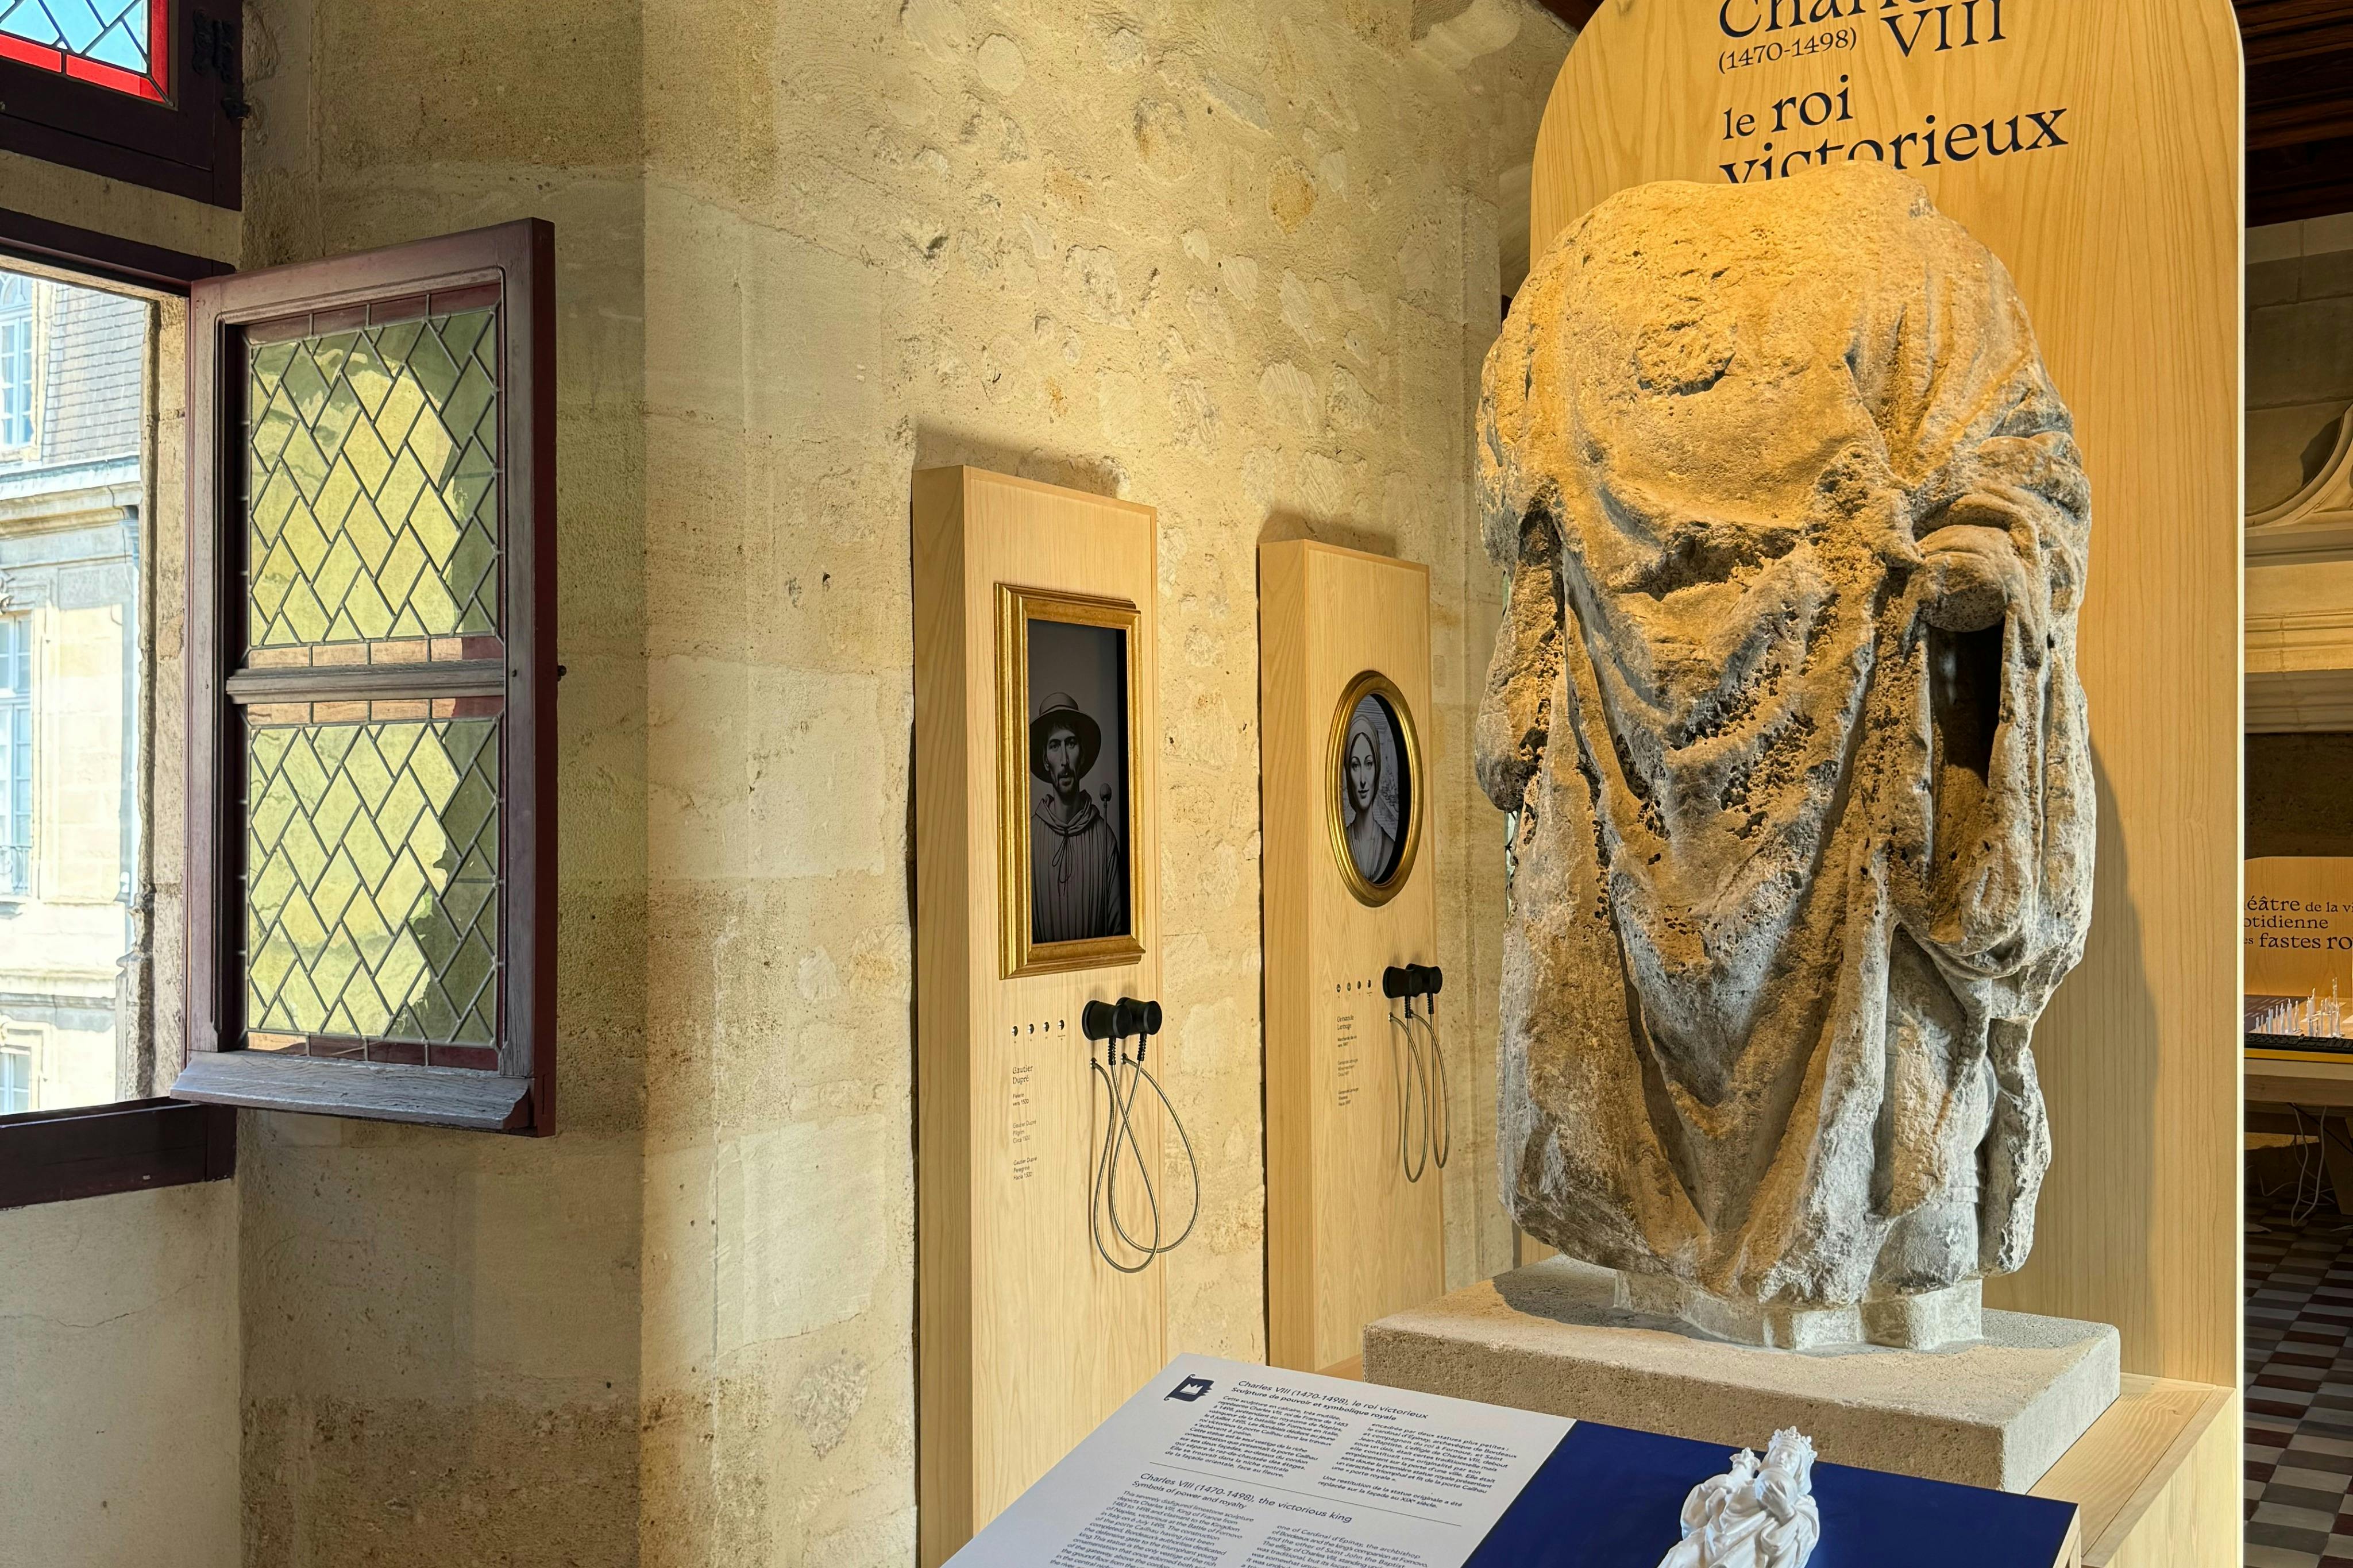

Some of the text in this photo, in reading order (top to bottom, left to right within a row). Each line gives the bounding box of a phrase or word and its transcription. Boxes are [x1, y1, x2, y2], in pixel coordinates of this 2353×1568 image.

[1881, 0, 2007, 57] VIII
[1719, 27, 1857, 74] (1470-1498)
[1723, 75, 1854, 140] le roi
[2244, 895, 2300, 912] éâtre
[2305, 902, 2321, 912] de
[2326, 902, 2338, 912] la
[2244, 914, 2328, 929] otidienne
[2259, 932, 2321, 949] fastes
[2327, 936, 2353, 949] ro
[1013, 1065, 1033, 1074] Gautier
[1013, 1075, 1029, 1085] Dupré
[1230, 1387, 1267, 1397] Sculpture
[1279, 1397, 1312, 1405] pouvoir
[1322, 1404, 1370, 1415] symbolique
[1236, 1380, 1272, 1391] Charles
[1289, 1389, 1349, 1405] (1470-1498),
[1378, 1405, 1429, 1418] victorieux
[1371, 1434, 1412, 1444] compagnon
[1441, 1446, 1472, 1456] Fornoue,
[1344, 1452, 1390, 1462] emplacement
[1363, 1450, 1401, 1458] constituait
[1416, 1459, 1453, 1468] originalité
[1131, 1480, 1165, 1491] Symbols
[1174, 1490, 1201, 1499] power
[1218, 1500, 1247, 1509] royalty
[1139, 1472, 1353, 1523] Charles VIII (1470-1498), the victorious king
[1336, 1479, 1371, 1488] restitution
[1413, 1494, 1443, 1502] originale
[1300, 1529, 1332, 1539] Cardinal
[1331, 1536, 1363, 1547] d'Épinay,
[1379, 1547, 1421, 1559] archbishop
